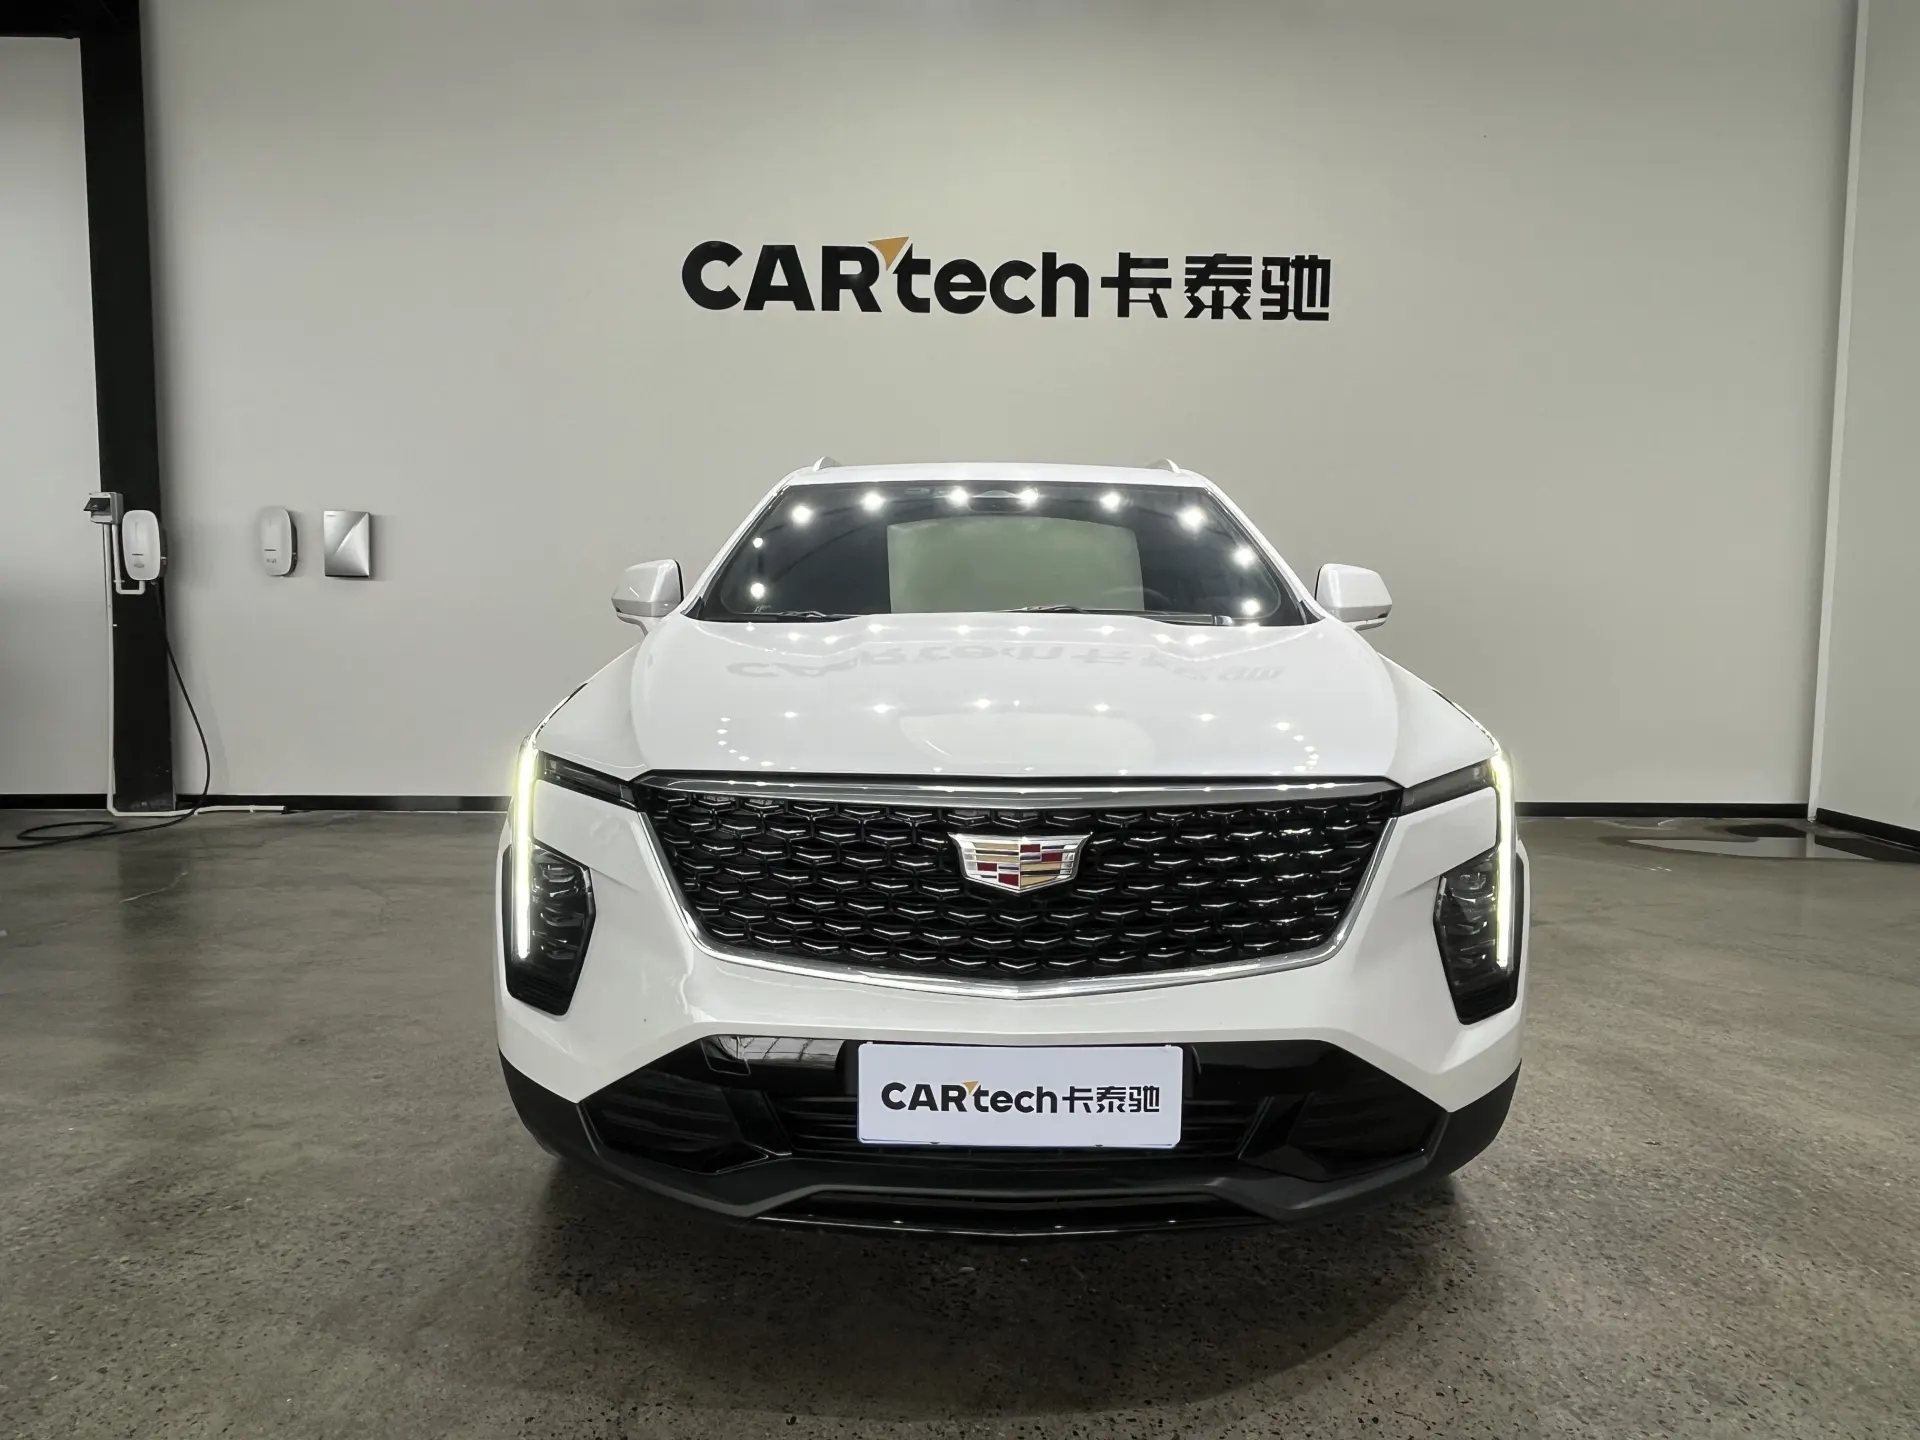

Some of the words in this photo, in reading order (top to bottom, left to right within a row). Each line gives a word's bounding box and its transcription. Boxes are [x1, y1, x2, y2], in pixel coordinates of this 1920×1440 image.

[681, 238, 1090, 318] CARtech
[1100, 251, 1332, 322] 卡泰驰
[881, 1081, 1058, 1113] CARtech
[1061, 1085, 1160, 1113] 卡泰驰
